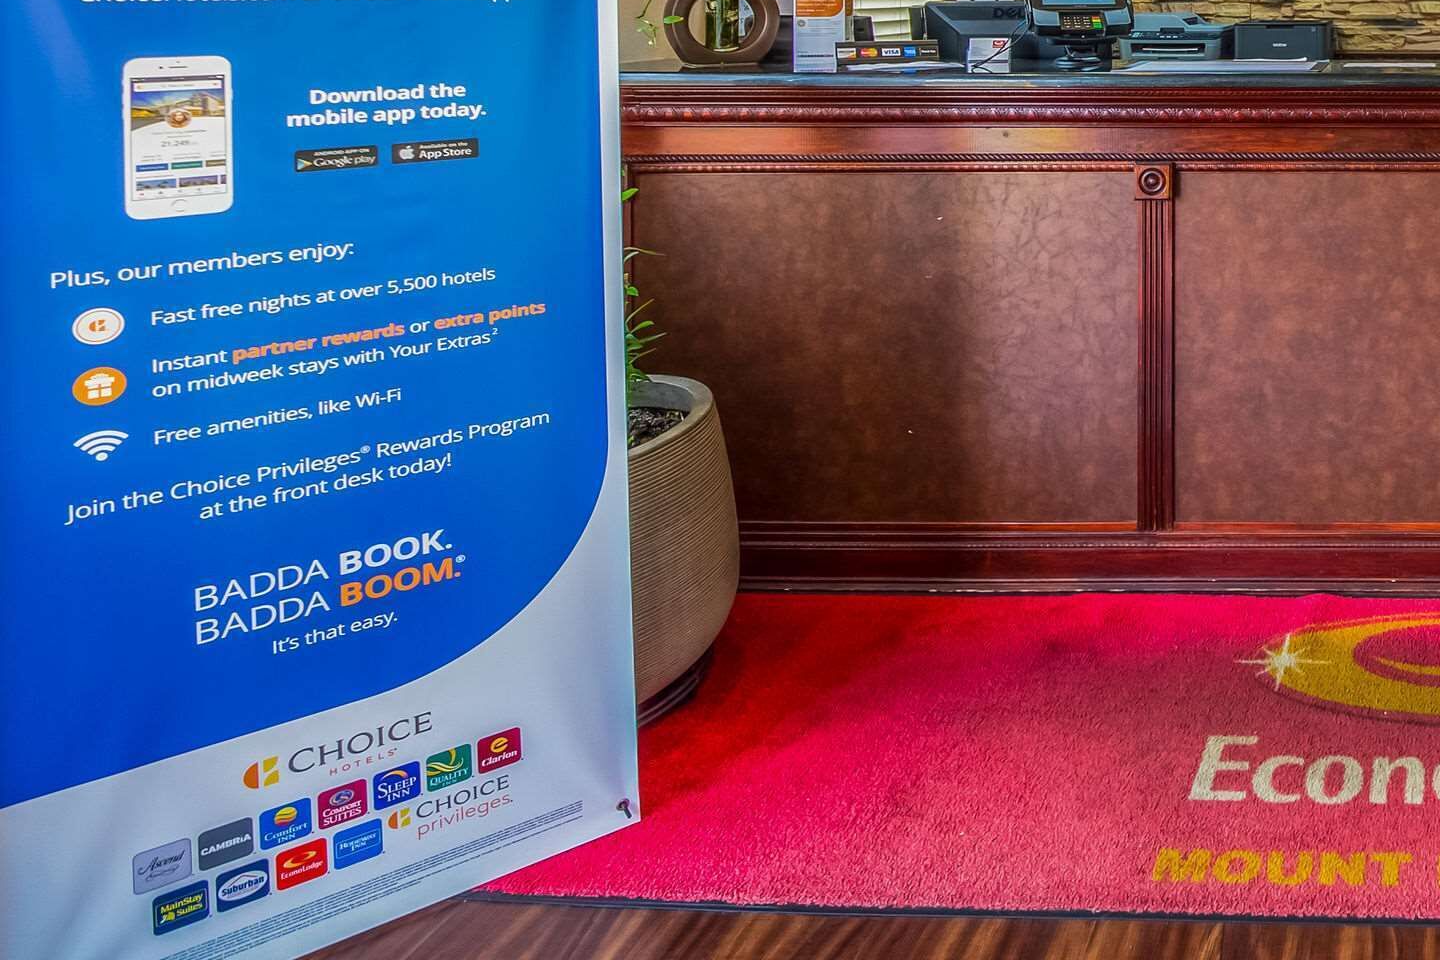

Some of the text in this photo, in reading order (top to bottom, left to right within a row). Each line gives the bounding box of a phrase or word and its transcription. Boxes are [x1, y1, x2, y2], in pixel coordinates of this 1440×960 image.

[309, 83, 466, 105] Download the
[286, 102, 487, 128] mobile app today.
[313, 154, 376, 167] Google play
[419, 147, 472, 161] App Store
[50, 242, 354, 289] Plus, our members enjoy:
[151, 267, 496, 326] Fast free nights at over 5,500 hotels
[152, 302, 546, 373] Instant partner rewards or extra points
[152, 382, 181, 398] on
[188, 363, 283, 392] midweek
[288, 356, 339, 376] stays
[343, 348, 385, 366] with
[389, 341, 432, 359] Your
[153, 387, 402, 445] Free amenities, like Wi-Fi
[64, 499, 116, 526] Join
[122, 490, 164, 511] the
[170, 473, 250, 500] Choice
[376, 428, 464, 458] Rewards
[468, 411, 550, 440] Program
[199, 452, 452, 520] at the front desk today!
[194, 528, 453, 612] BADDA BOOK.
[195, 591, 331, 645] BADDA
[272, 611, 399, 655] It's that easy.
[287, 711, 433, 775] CHOICE
[329, 749, 396, 776] HOTELS
[481, 749, 518, 767] Clarion
[377, 776, 417, 800] SLEEP
[429, 766, 469, 787] QUALITY
[387, 787, 410, 802] INN
[416, 774, 511, 818] CHOICE
[323, 806, 362, 827] SUITES
[264, 822, 308, 842] Comfort
[277, 832, 296, 844] INN
[280, 859, 324, 880] EconoLodge
[1151, 848, 1413, 887] MOUNT
[221, 875, 265, 896] Suburban
[160, 892, 204, 915] MainStay
[176, 902, 203, 917] Suites
